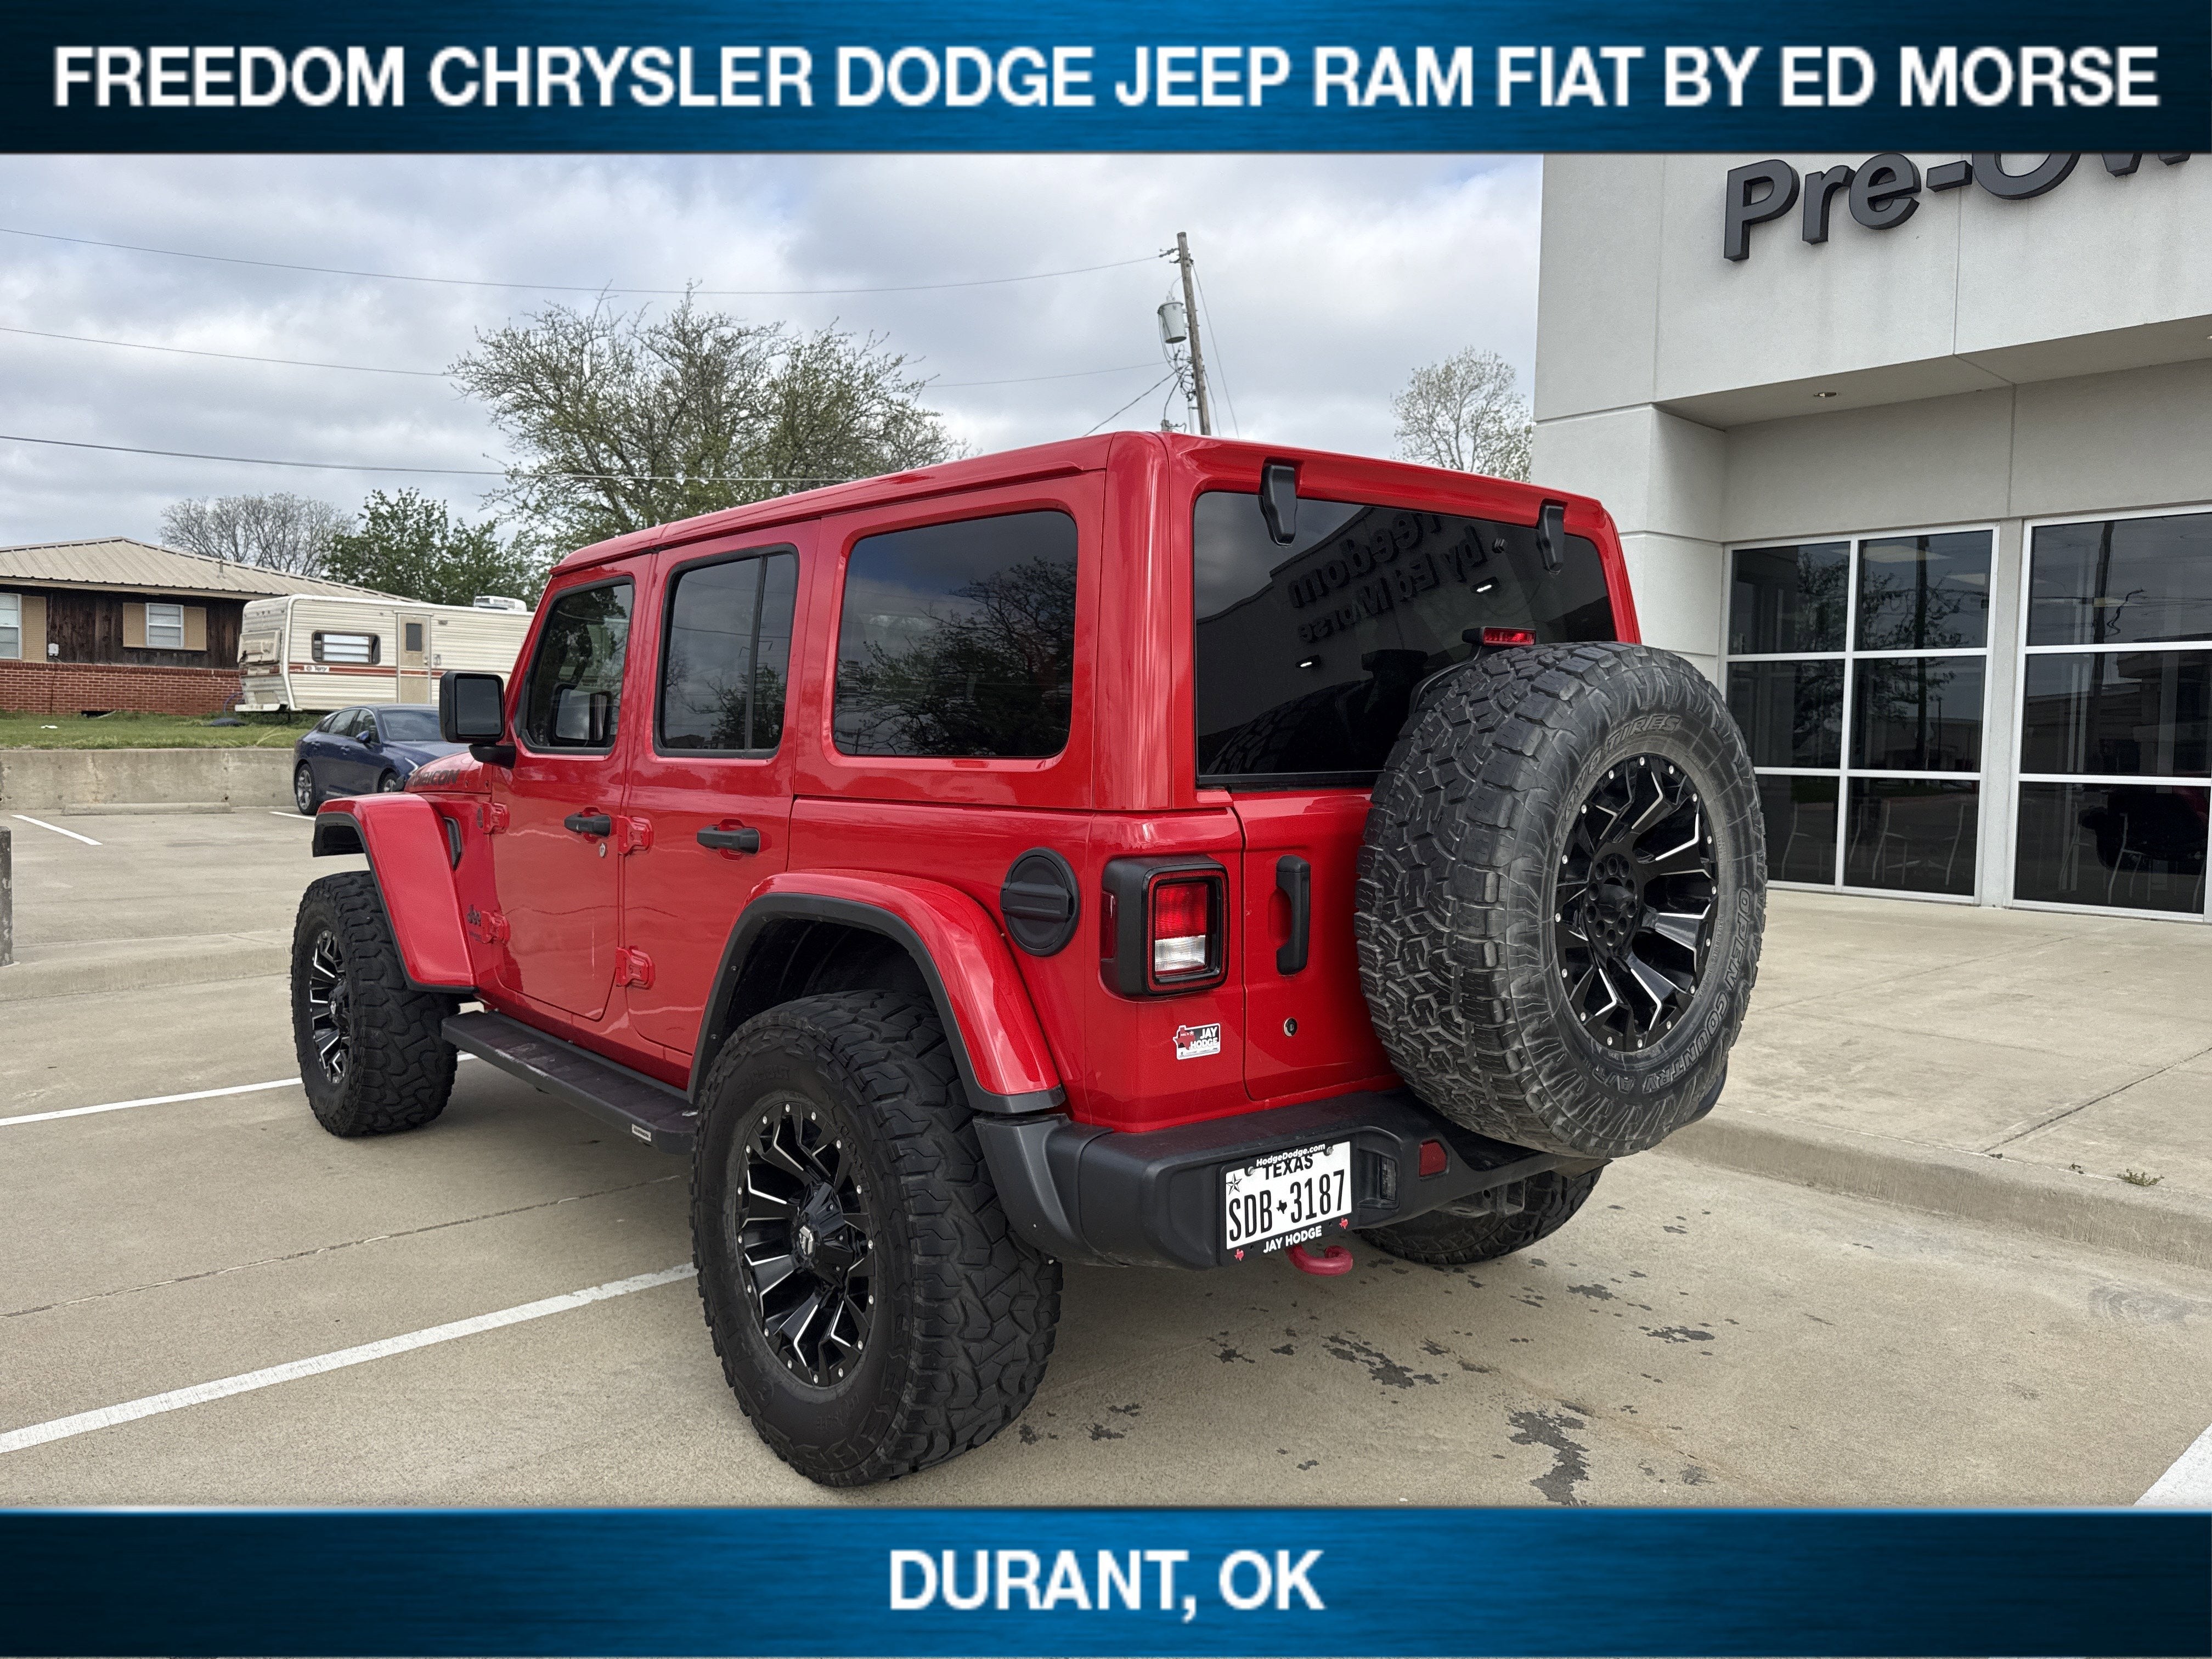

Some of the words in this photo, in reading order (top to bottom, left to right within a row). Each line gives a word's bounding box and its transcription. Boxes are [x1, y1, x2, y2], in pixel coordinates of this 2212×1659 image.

[1605, 713, 1682, 753] TIRES
[409, 769, 461, 786] BICON
[1724, 888, 1751, 991] OPEN
[1190, 1037, 1218, 1050] HODGE
[1200, 1026, 1218, 1039] JAY
[1643, 991, 1728, 1094] COUNTRY
[1256, 1143, 1325, 1167] HodgeDodge.com
[1262, 1155, 1313, 1180] TEXAS
[1228, 1189, 1273, 1242] SDB
[1290, 1169, 1345, 1223] 3187
[1263, 1237, 1283, 1253] JAY
[1285, 1225, 1322, 1246] HODGE
